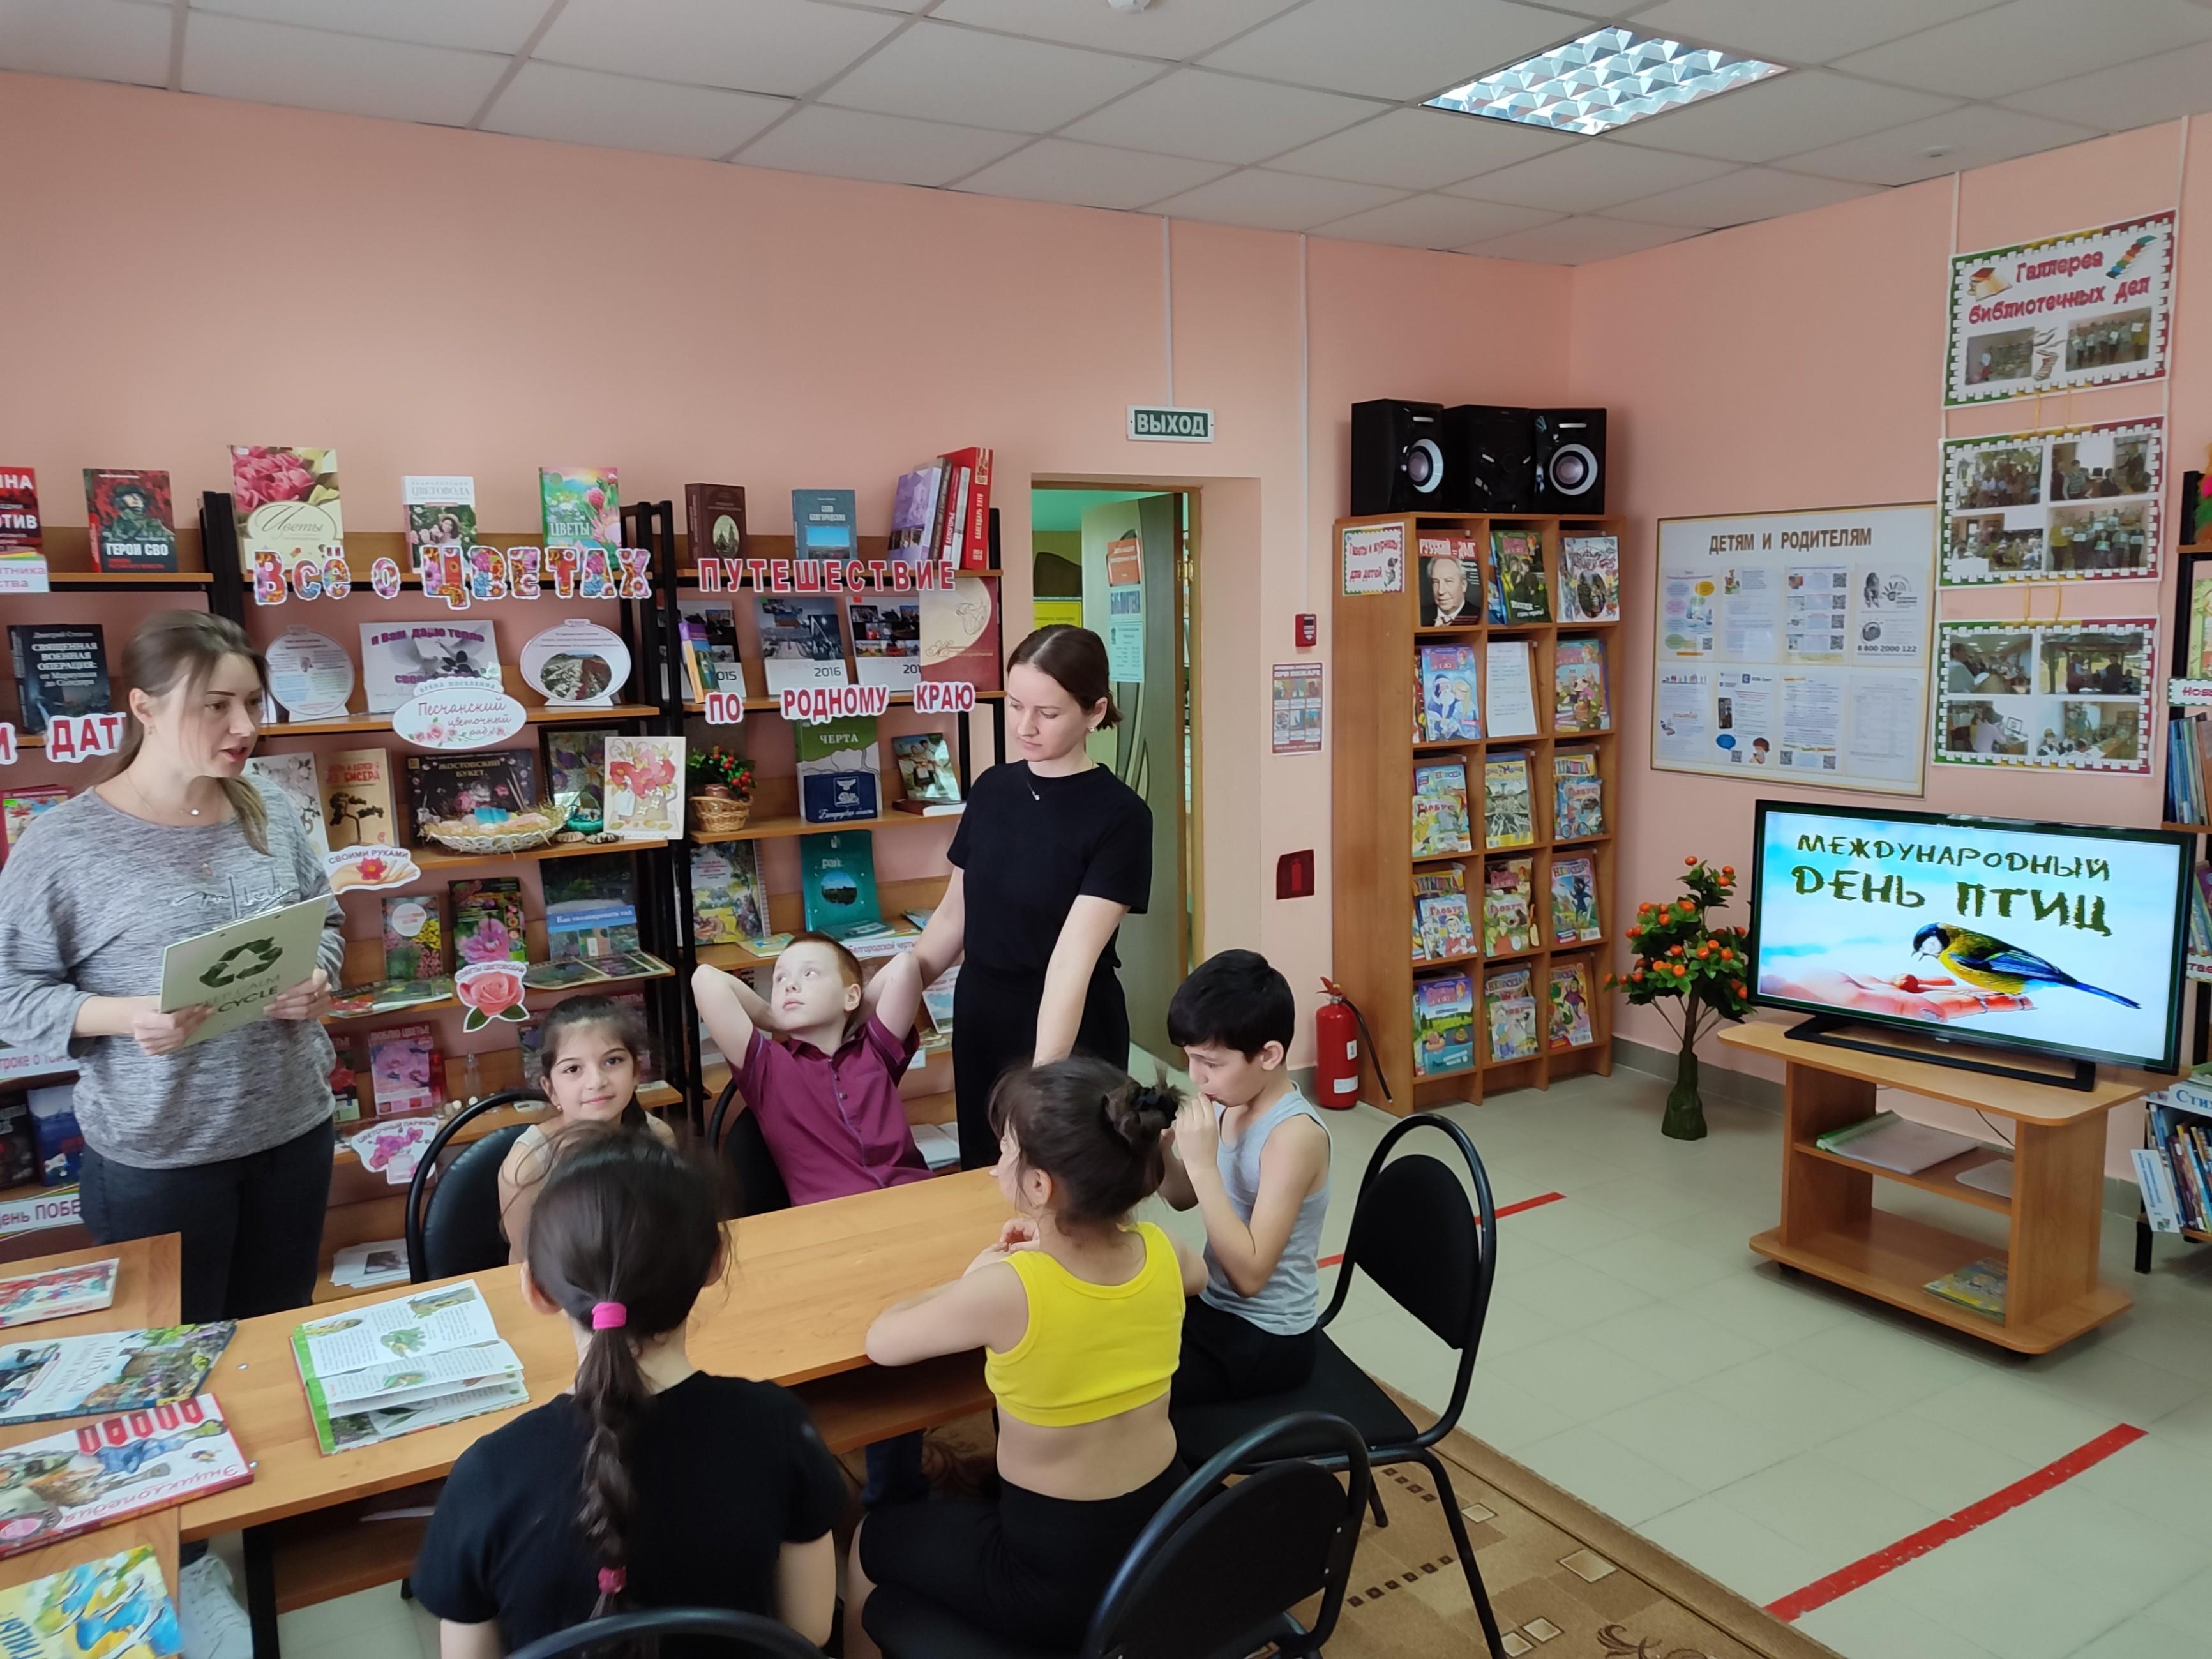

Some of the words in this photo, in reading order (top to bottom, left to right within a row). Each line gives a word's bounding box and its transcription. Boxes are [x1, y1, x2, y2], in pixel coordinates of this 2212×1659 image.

[2016, 251, 2103, 282] Галлерея
[1969, 285, 2105, 324] библиотечных
[2113, 277, 2151, 304] дел
[1136, 414, 1205, 435] ВЫХОД
[412, 486, 470, 496] ЦВЕТОВОДА
[255, 504, 324, 534] Цветы
[549, 522, 591, 537] ЦВЕТЫ
[144, 544, 169, 556] СВО
[1709, 534, 1754, 555] ДЕТЯМ
[1762, 533, 1772, 550] И
[1780, 528, 1872, 552] РОДИТЕЛЯМ
[421, 547, 651, 608] ЦВЕТАХ
[699, 558, 956, 592] ПУТЕШЕСТВИЕ
[41, 651, 92, 661] ВОЕННАЯ
[716, 670, 738, 681] 015
[814, 666, 842, 677] 2016
[903, 664, 921, 675] 201
[418, 696, 506, 716] Песчанский
[709, 694, 741, 722] ПО
[783, 686, 887, 722] РОДНОМУ
[915, 684, 973, 712] КРАЮ
[448, 714, 511, 728] цветочный
[819, 733, 859, 744] ЧЕРТА
[328, 850, 370, 865] СВОИМИ
[371, 848, 409, 859] РУКАМИ
[1797, 834, 2110, 882] МЕЖДУНАРОДНЫЙ
[1791, 864, 1926, 908] ДЕНЬ
[1956, 880, 2113, 937] ПТИЦ
[236, 974, 280, 996] CALM
[218, 985, 278, 1013] CYCLE
[357, 1123, 402, 1144] ЦВЕТОЧНЫЙ
[403, 1119, 437, 1127] ПАРФЮМ
[35, 1200, 81, 1221] ПОБЕ
